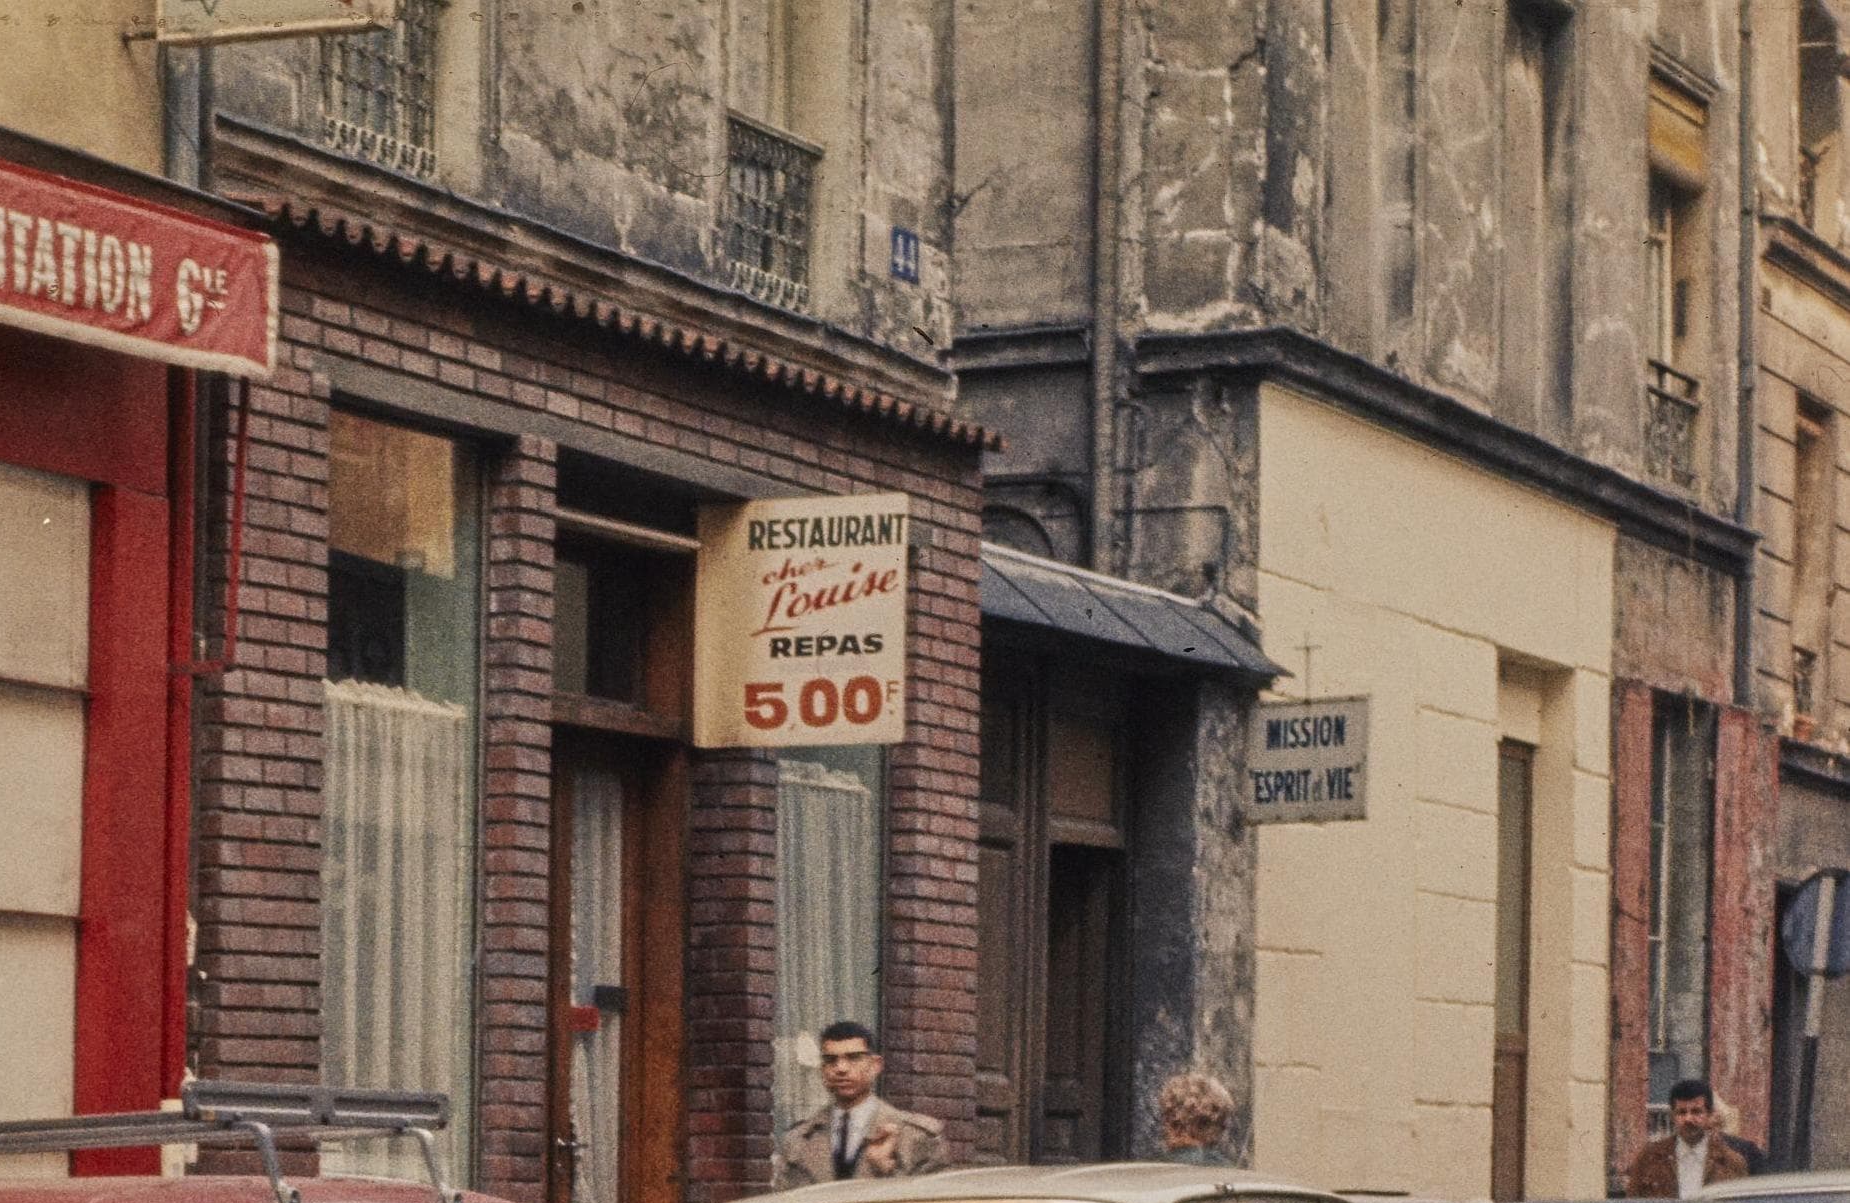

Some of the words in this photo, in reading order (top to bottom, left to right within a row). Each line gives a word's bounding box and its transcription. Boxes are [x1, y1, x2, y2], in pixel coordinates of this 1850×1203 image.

[893, 233, 917, 277] 44
[748, 513, 906, 551] RESTAURANT
[751, 561, 899, 637] Louise
[769, 633, 885, 659] REPAS
[1266, 715, 1347, 750] MISSION
